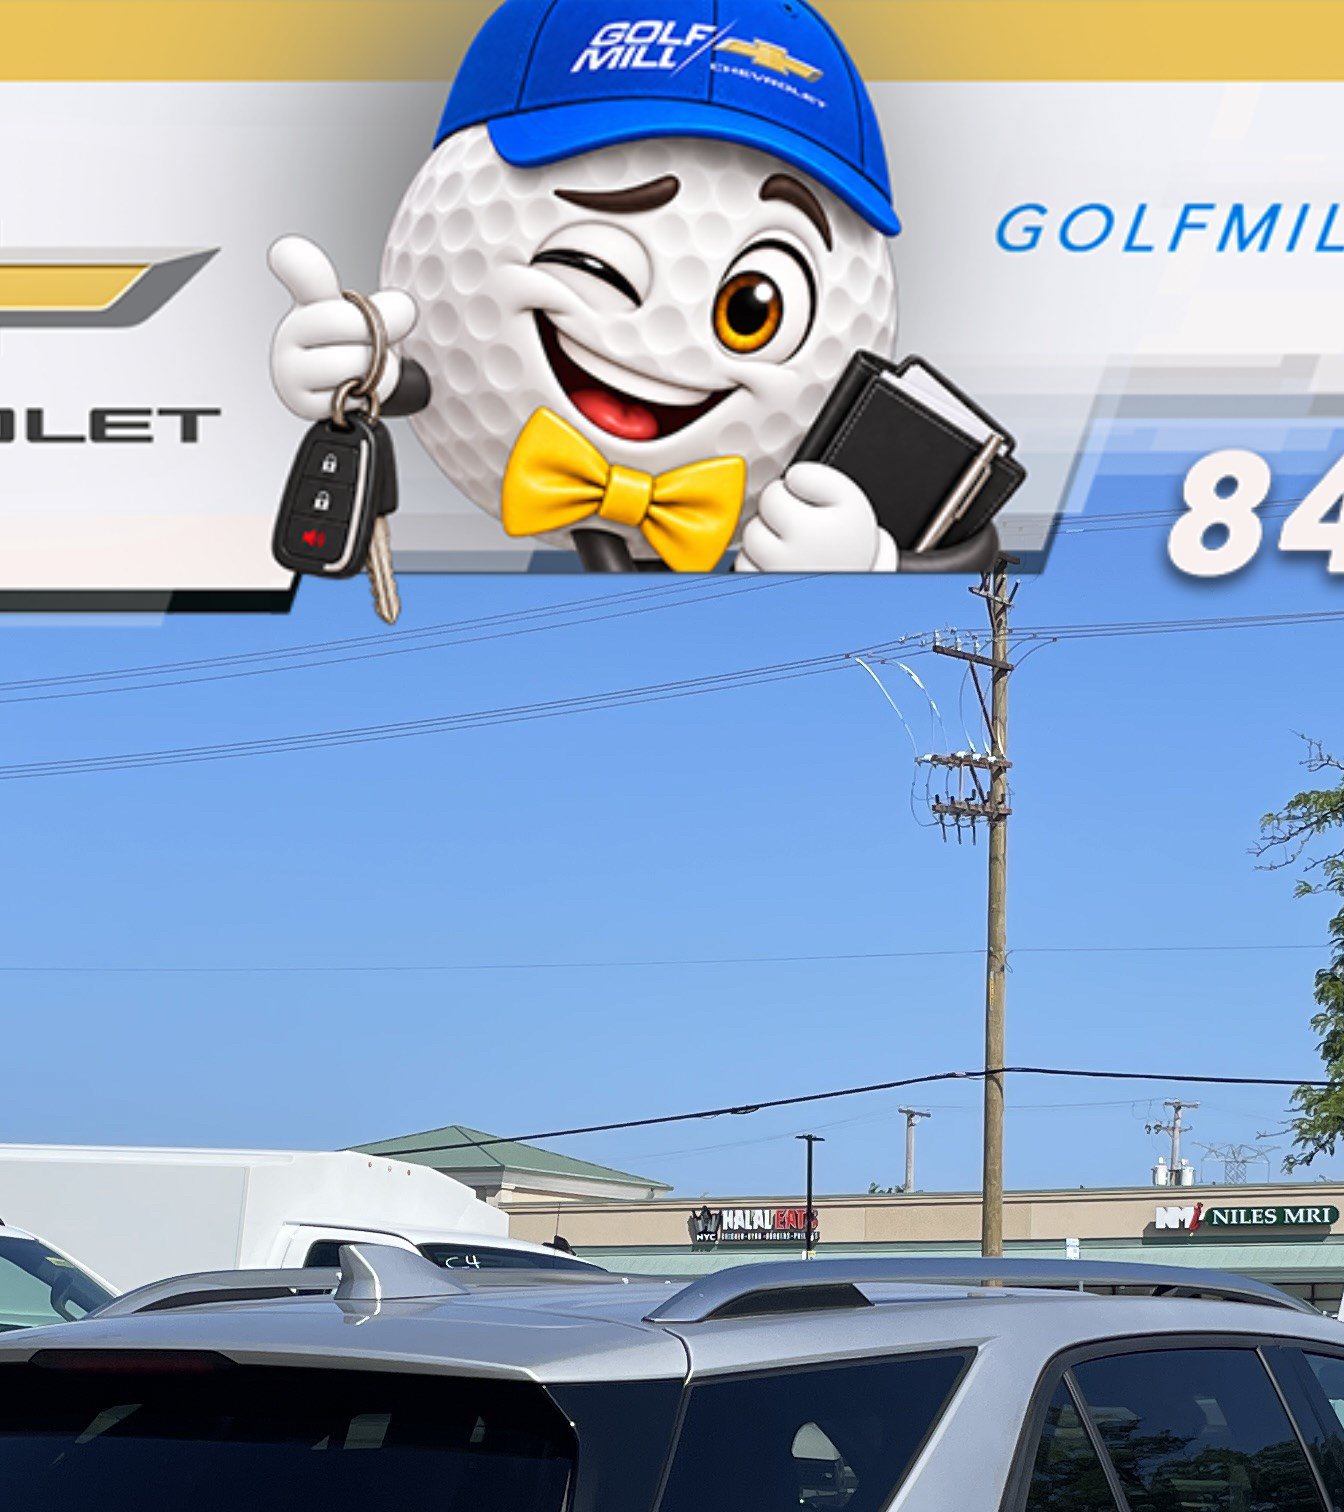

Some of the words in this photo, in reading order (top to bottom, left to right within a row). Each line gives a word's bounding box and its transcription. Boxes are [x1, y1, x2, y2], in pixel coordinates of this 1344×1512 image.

[722, 1208, 773, 1230] HALAL
[1212, 1208, 1277, 1225] NILES
[1284, 1207, 1331, 1223] MRI
[696, 1233, 716, 1241] NYC
